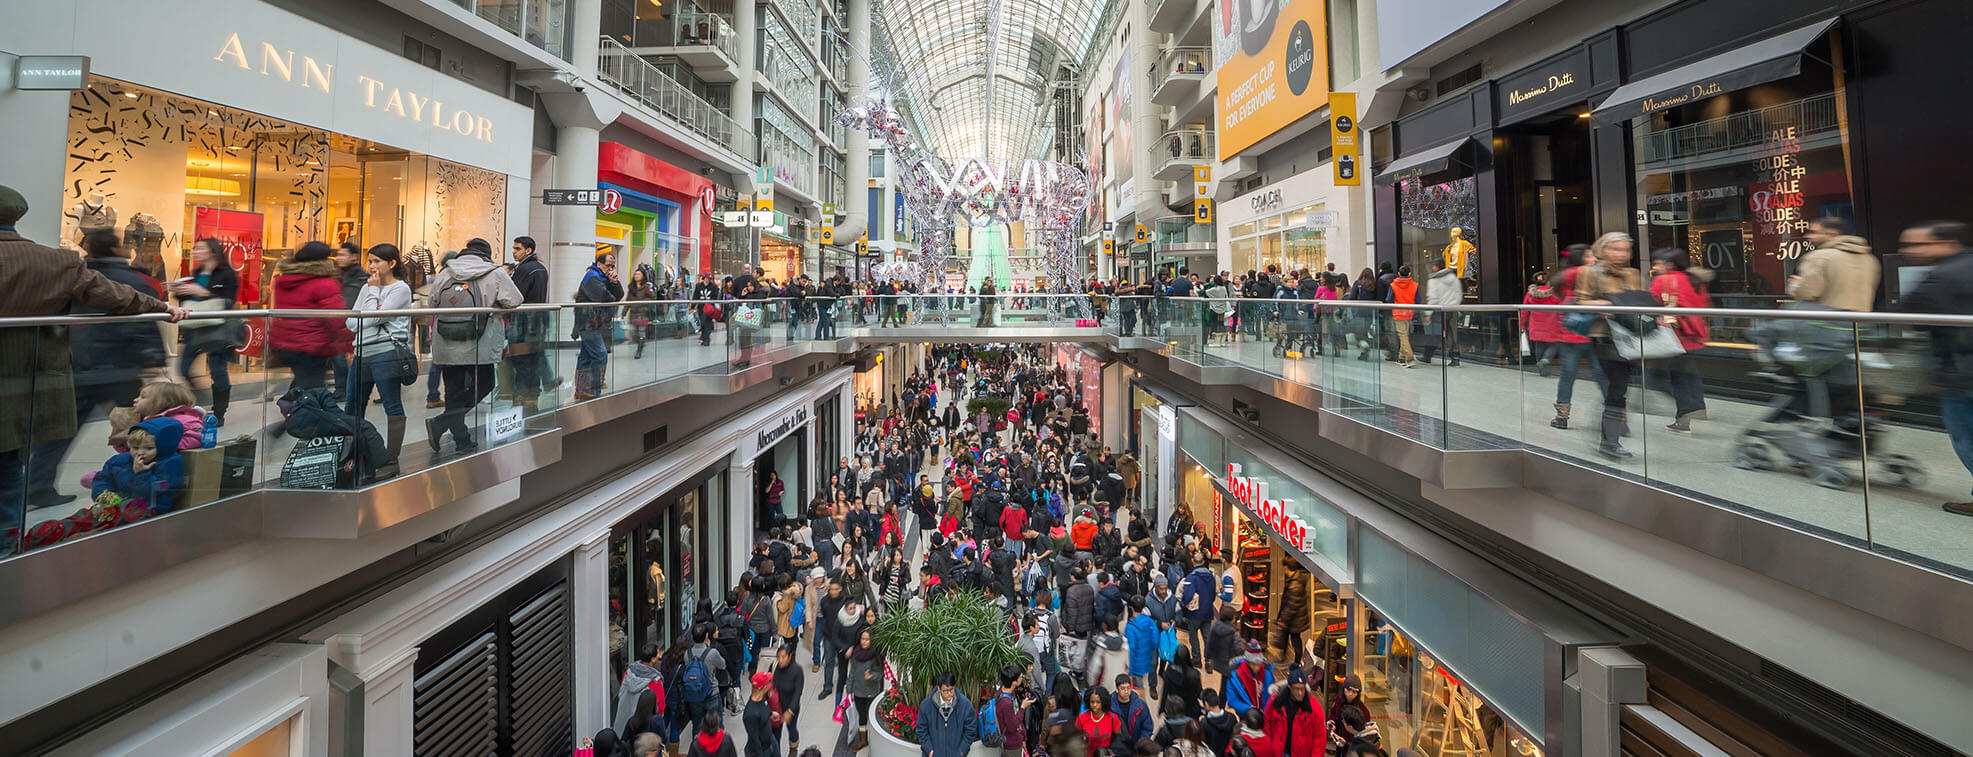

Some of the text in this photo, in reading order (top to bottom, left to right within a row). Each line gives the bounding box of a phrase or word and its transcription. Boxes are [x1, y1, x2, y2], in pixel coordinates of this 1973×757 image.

[1288, 48, 1311, 74] KEURIG
[212, 31, 494, 144] ANN TAYLOR
[1225, 60, 1275, 111] A PERFECT CUP
[1509, 72, 1574, 106] Massimo Dutti
[1642, 82, 1722, 113] Massimo Dutti
[1225, 83, 1276, 131] FOR EVERYONE
[1769, 127, 1795, 142] ALE
[1752, 154, 1798, 172] SOLDES
[1751, 192, 1805, 210] AJAS
[1768, 180, 1799, 194] SALE
[1251, 190, 1283, 213] COACH
[1755, 207, 1801, 223] SOLDES
[757, 415, 791, 452] Abercrombie
[1228, 463, 1309, 552] Foot Locker
